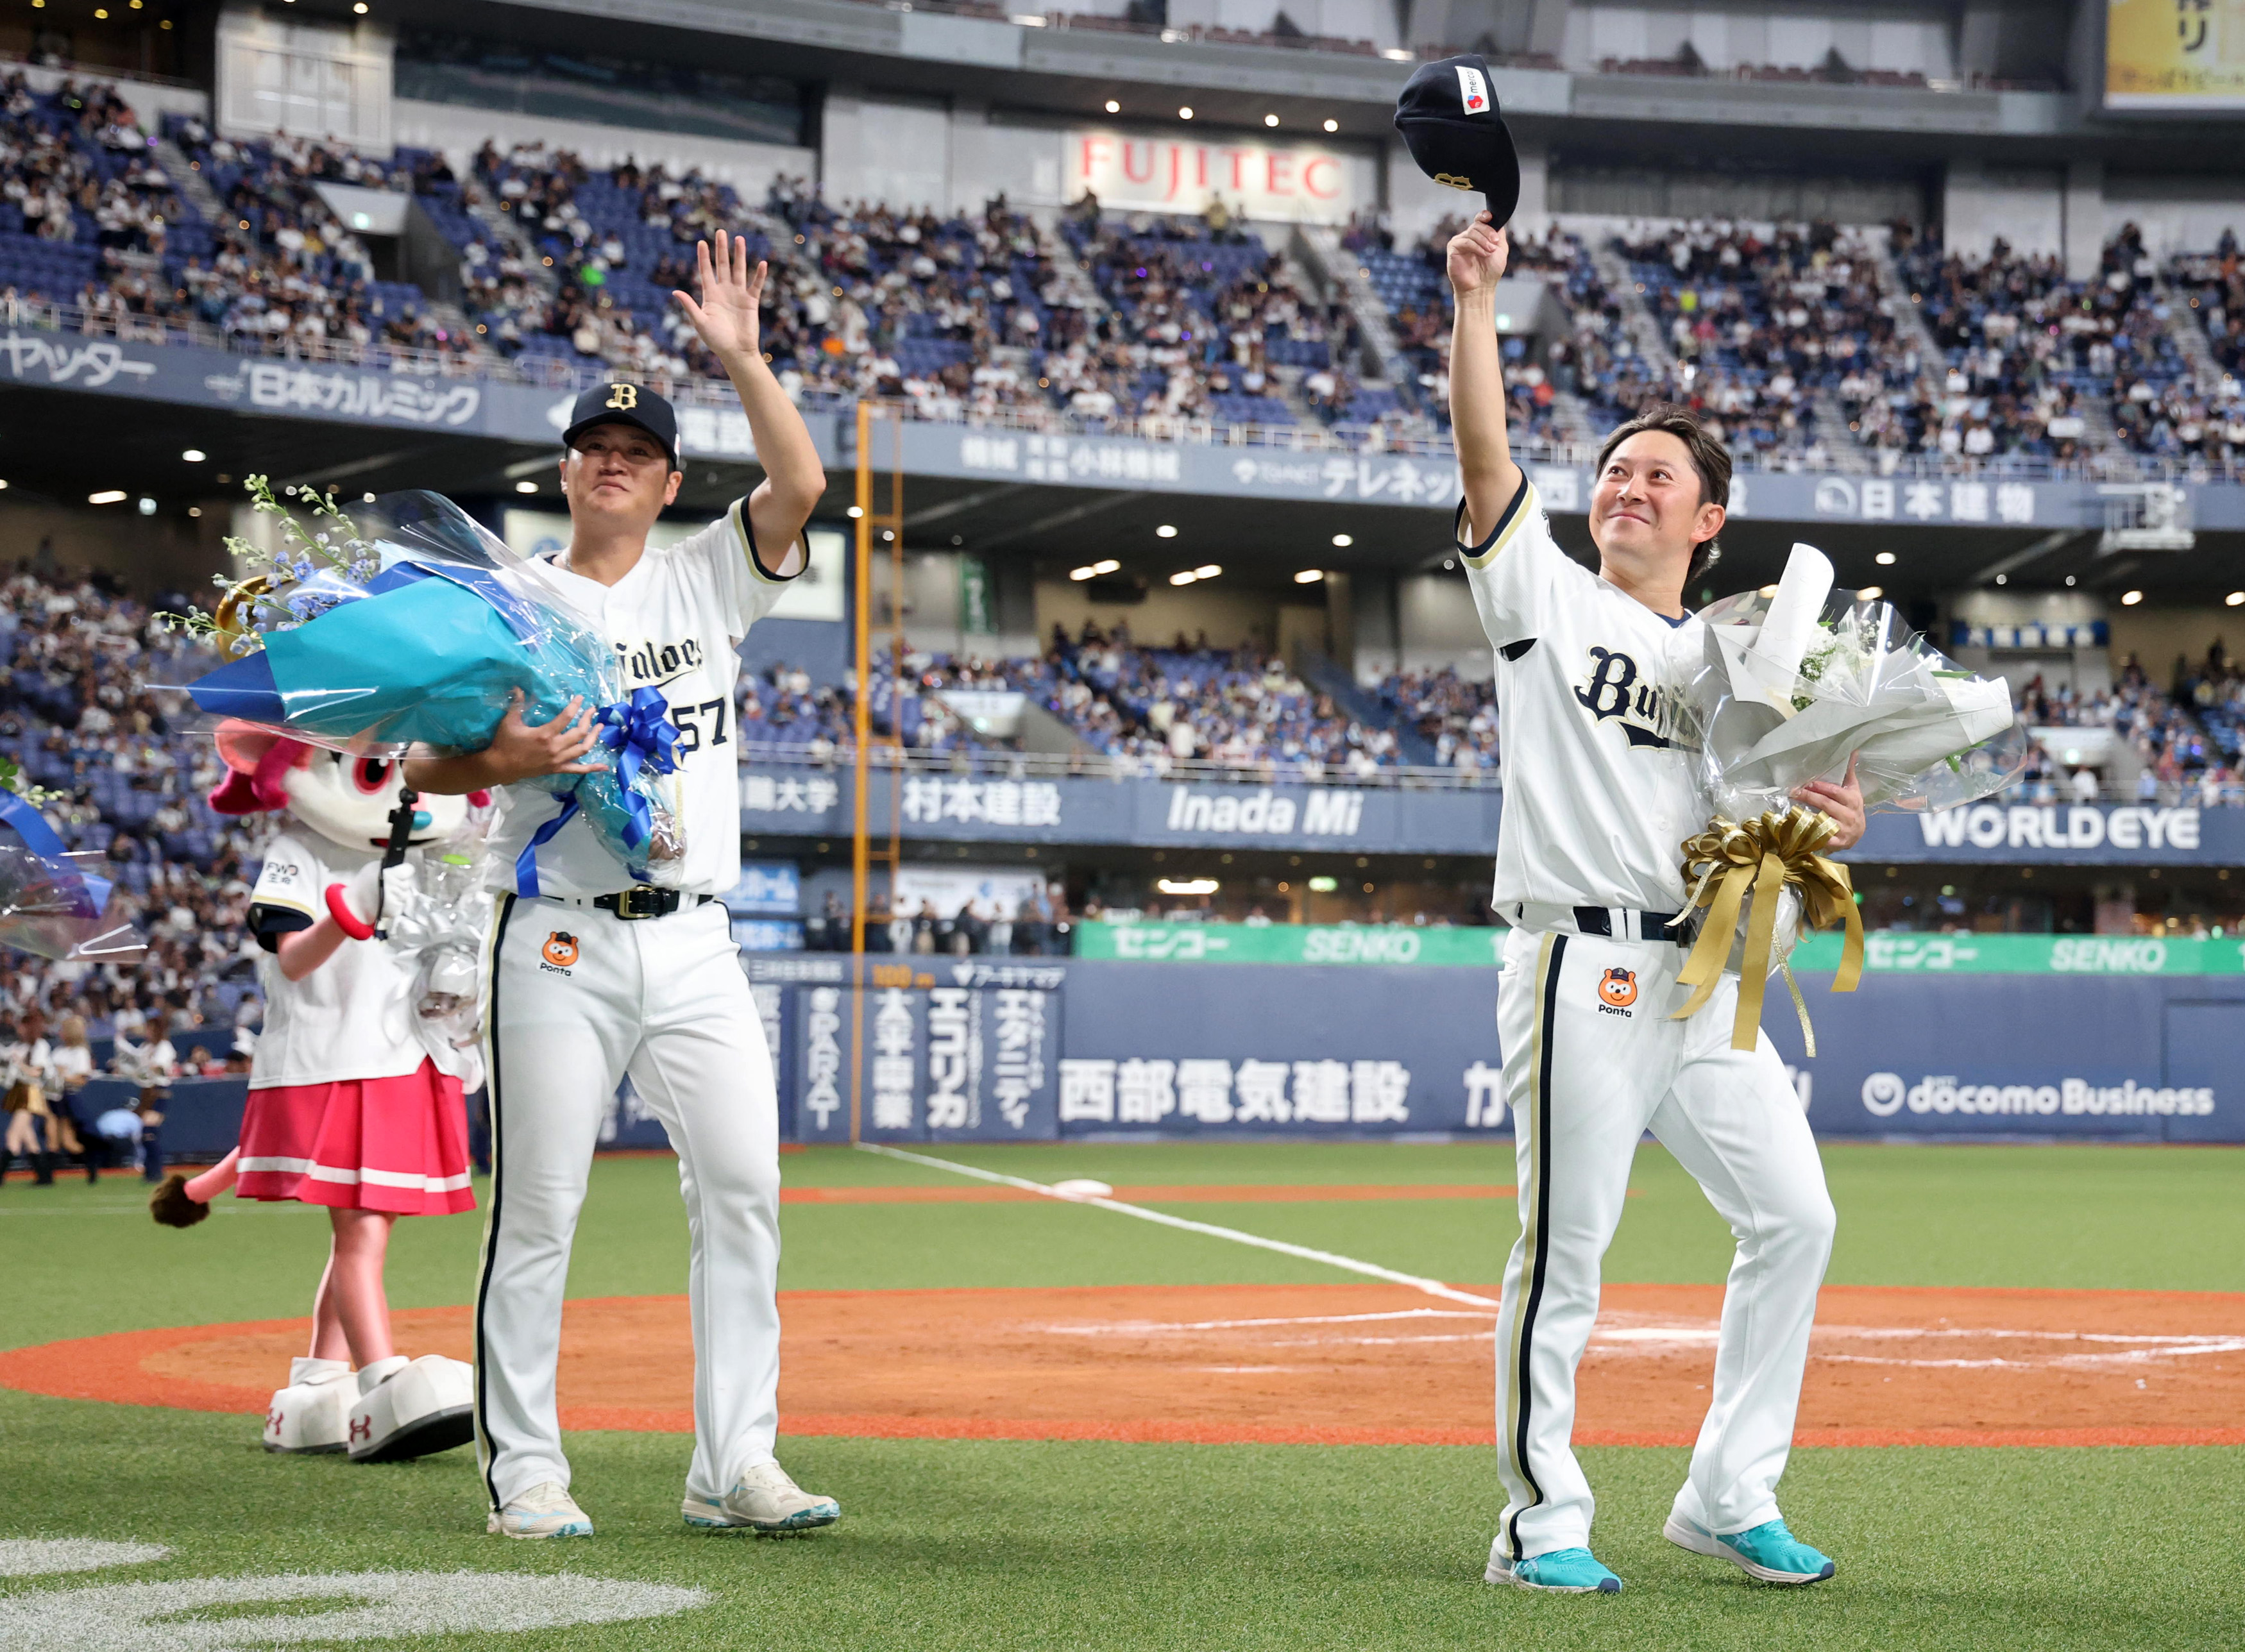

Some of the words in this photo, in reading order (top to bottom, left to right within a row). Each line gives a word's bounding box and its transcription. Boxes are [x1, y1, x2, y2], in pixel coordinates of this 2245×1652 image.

[1080, 136, 1343, 201] FUJITEC
[250, 363, 480, 425] 日本カルミック
[606, 384, 638, 410] B
[672, 697, 727, 752] 57
[902, 776, 1062, 827] 村本建設
[1167, 786, 1297, 834] Inada
[1303, 789, 1364, 835] Mi
[1112, 927, 1230, 959] センコー
[1303, 929, 1421, 962] SENKO
[1865, 938, 1981, 969] センコー
[2049, 938, 2167, 972] SENKO
[1598, 1004, 1632, 1018] Ponta
[927, 988, 970, 1129] エコリカ
[1058, 1058, 1411, 1124] 西部電気建設
[1906, 1076, 2061, 1115] docomo
[2061, 1078, 2216, 1117] Business
